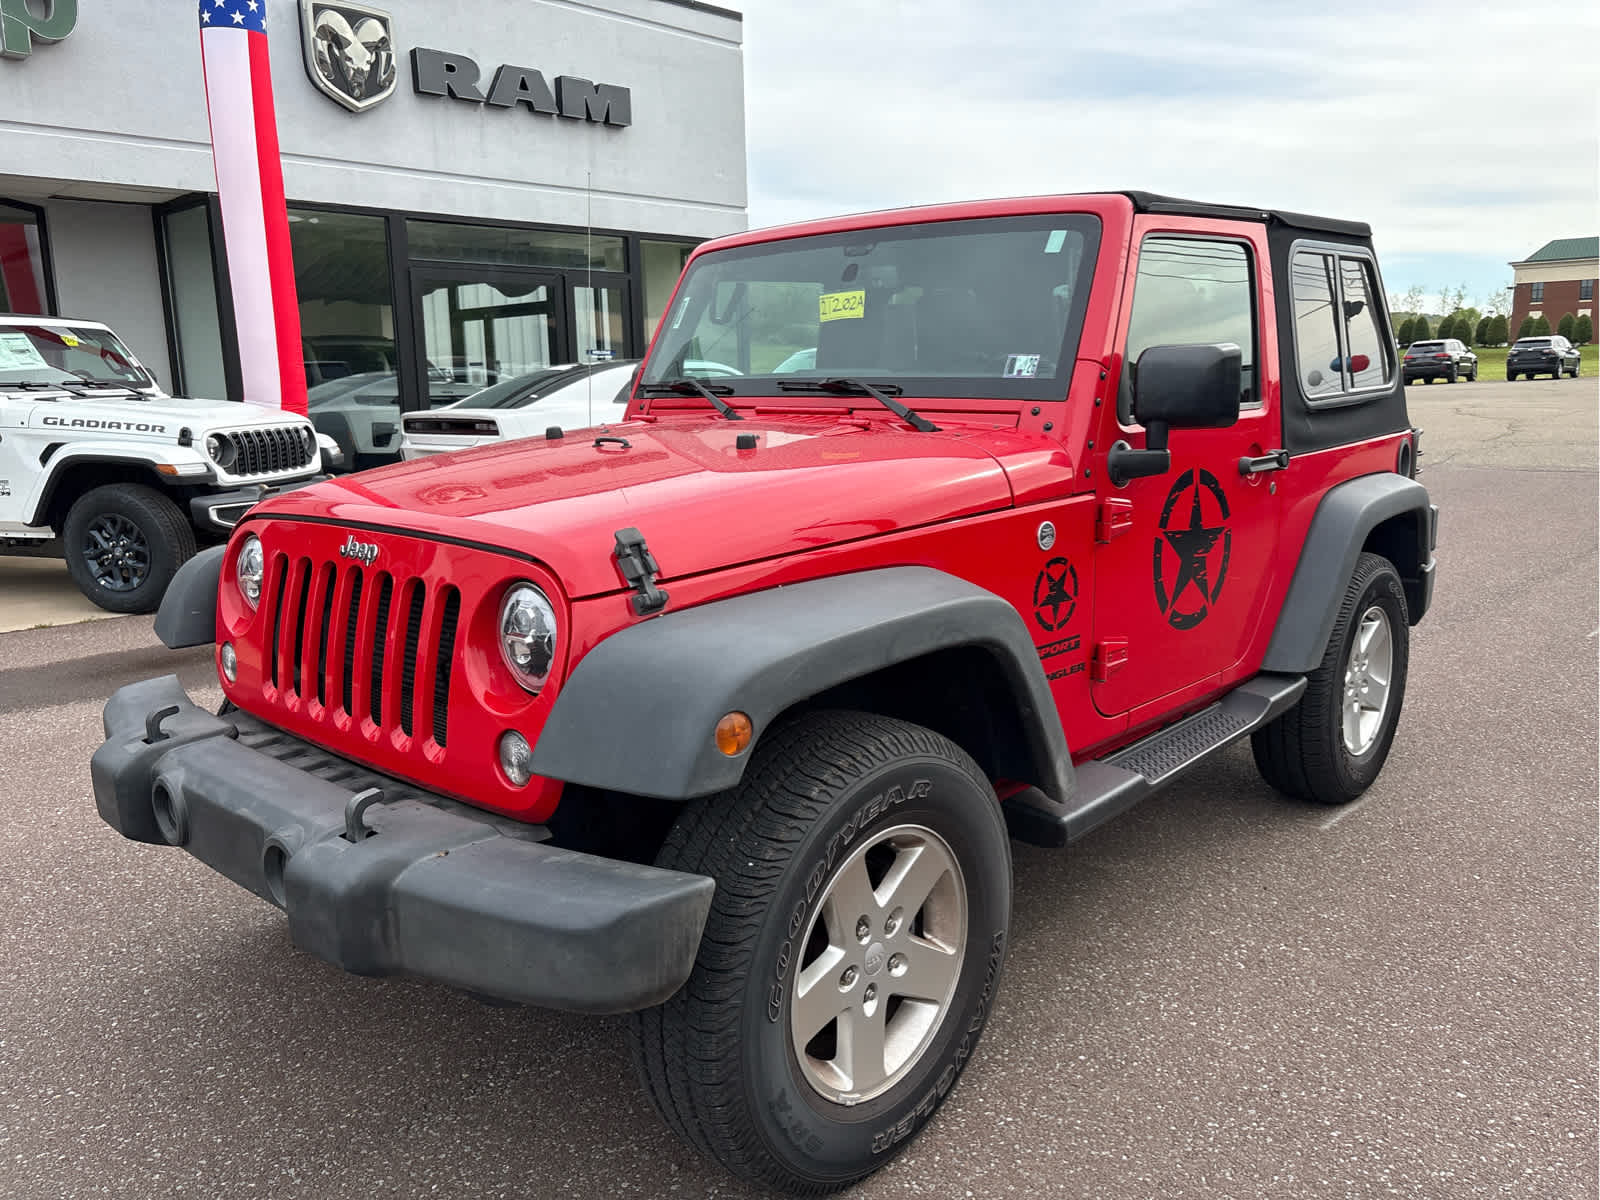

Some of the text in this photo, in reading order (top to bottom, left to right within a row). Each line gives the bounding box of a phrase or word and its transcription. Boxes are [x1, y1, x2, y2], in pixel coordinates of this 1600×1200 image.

[409, 47, 632, 127] RAM
[43, 416, 167, 434] GLADIATOR
[340, 534, 379, 567] Jeep
[1037, 636, 1081, 660] PORT
[1045, 662, 1086, 680] NGLER
[768, 779, 932, 1023] GOODYEAR
